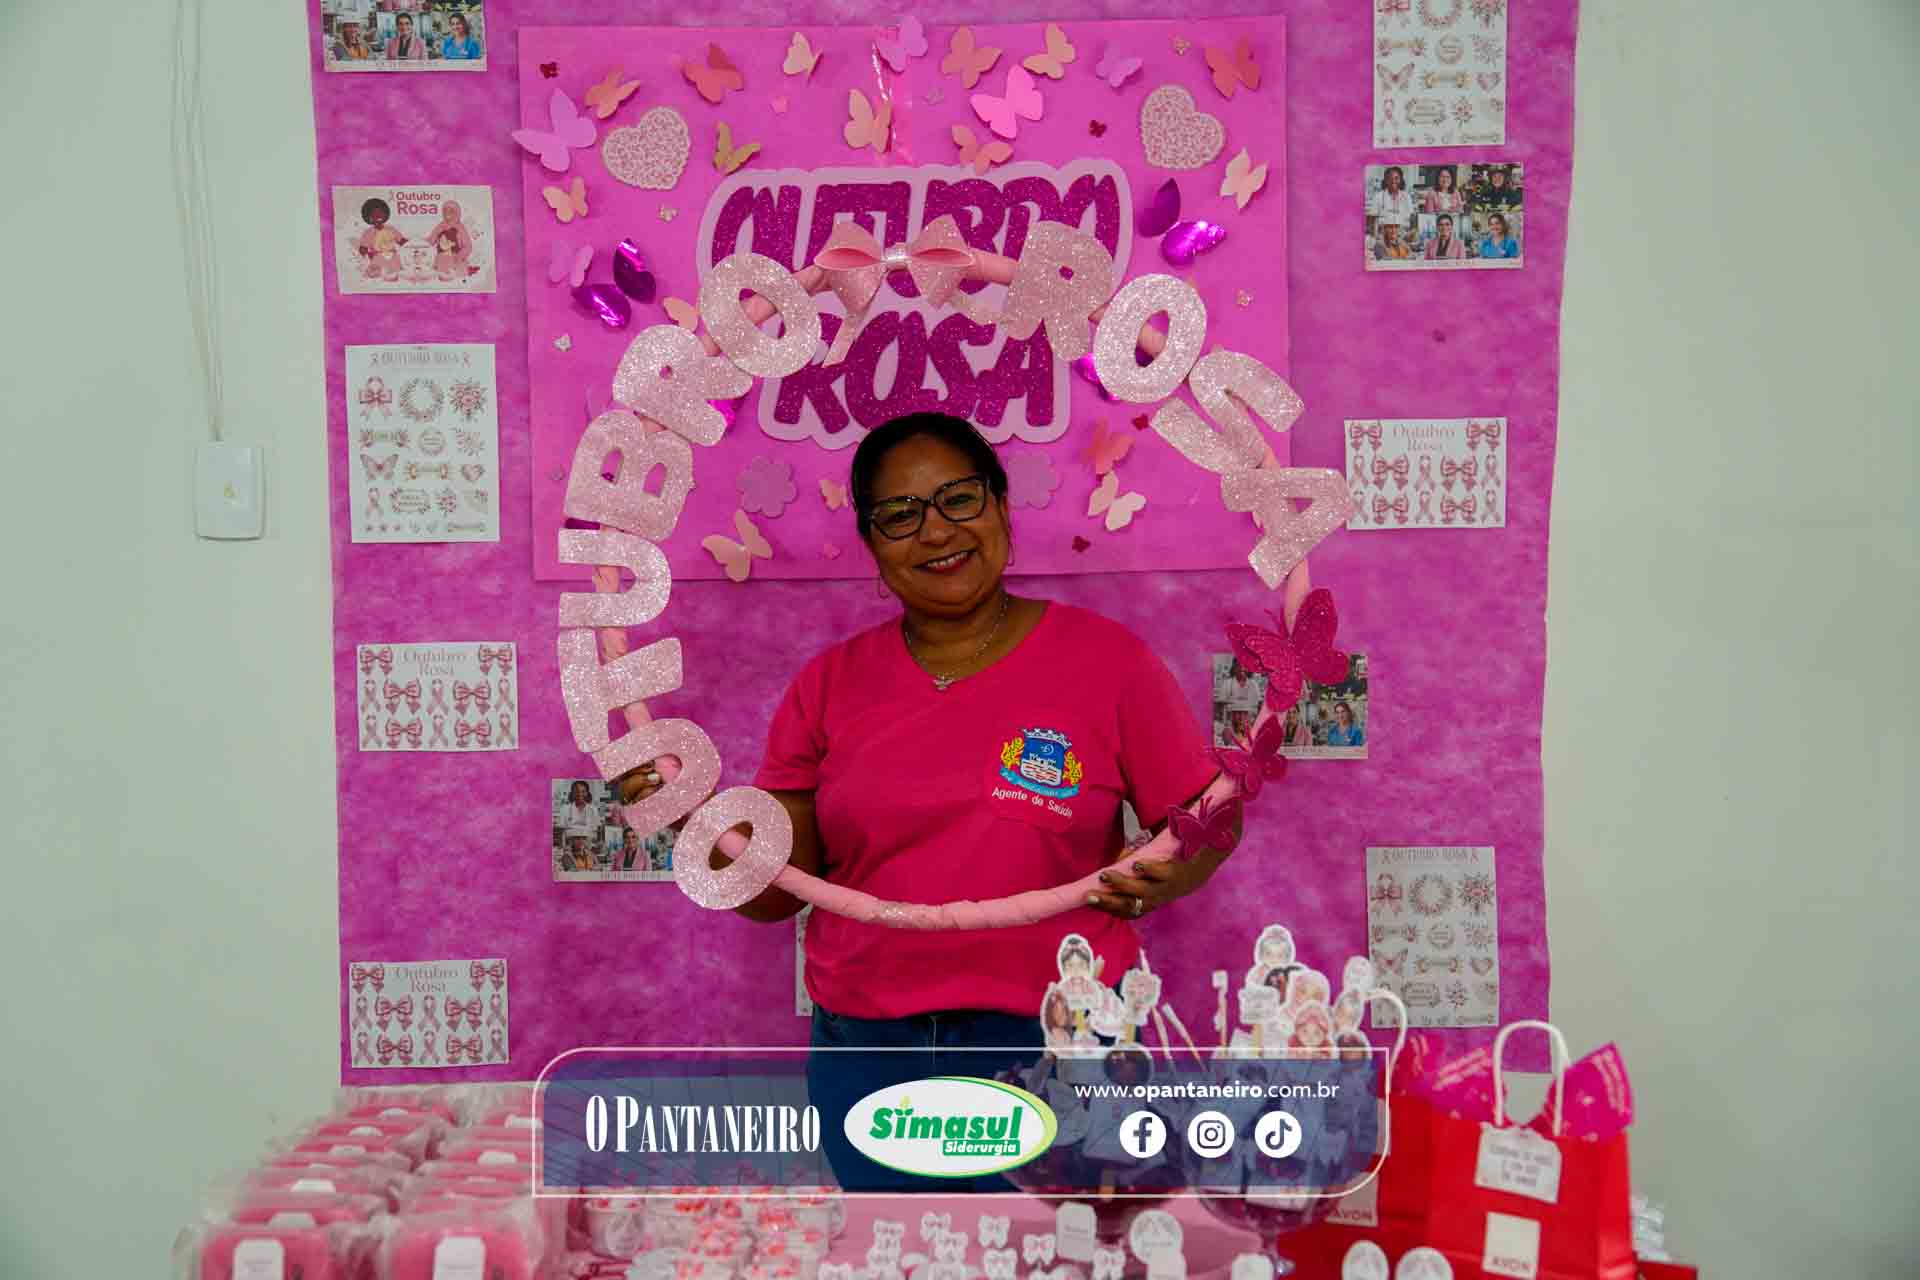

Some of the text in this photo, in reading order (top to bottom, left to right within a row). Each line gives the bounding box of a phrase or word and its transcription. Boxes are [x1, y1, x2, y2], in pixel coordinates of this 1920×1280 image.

[396, 191, 441, 201] Outubro
[397, 201, 438, 215] Rosa
[1005, 220, 1355, 590] ROSA
[992, 787, 1028, 801] Agente
[1032, 794, 1044, 807] de
[1048, 799, 1073, 818] Saúde
